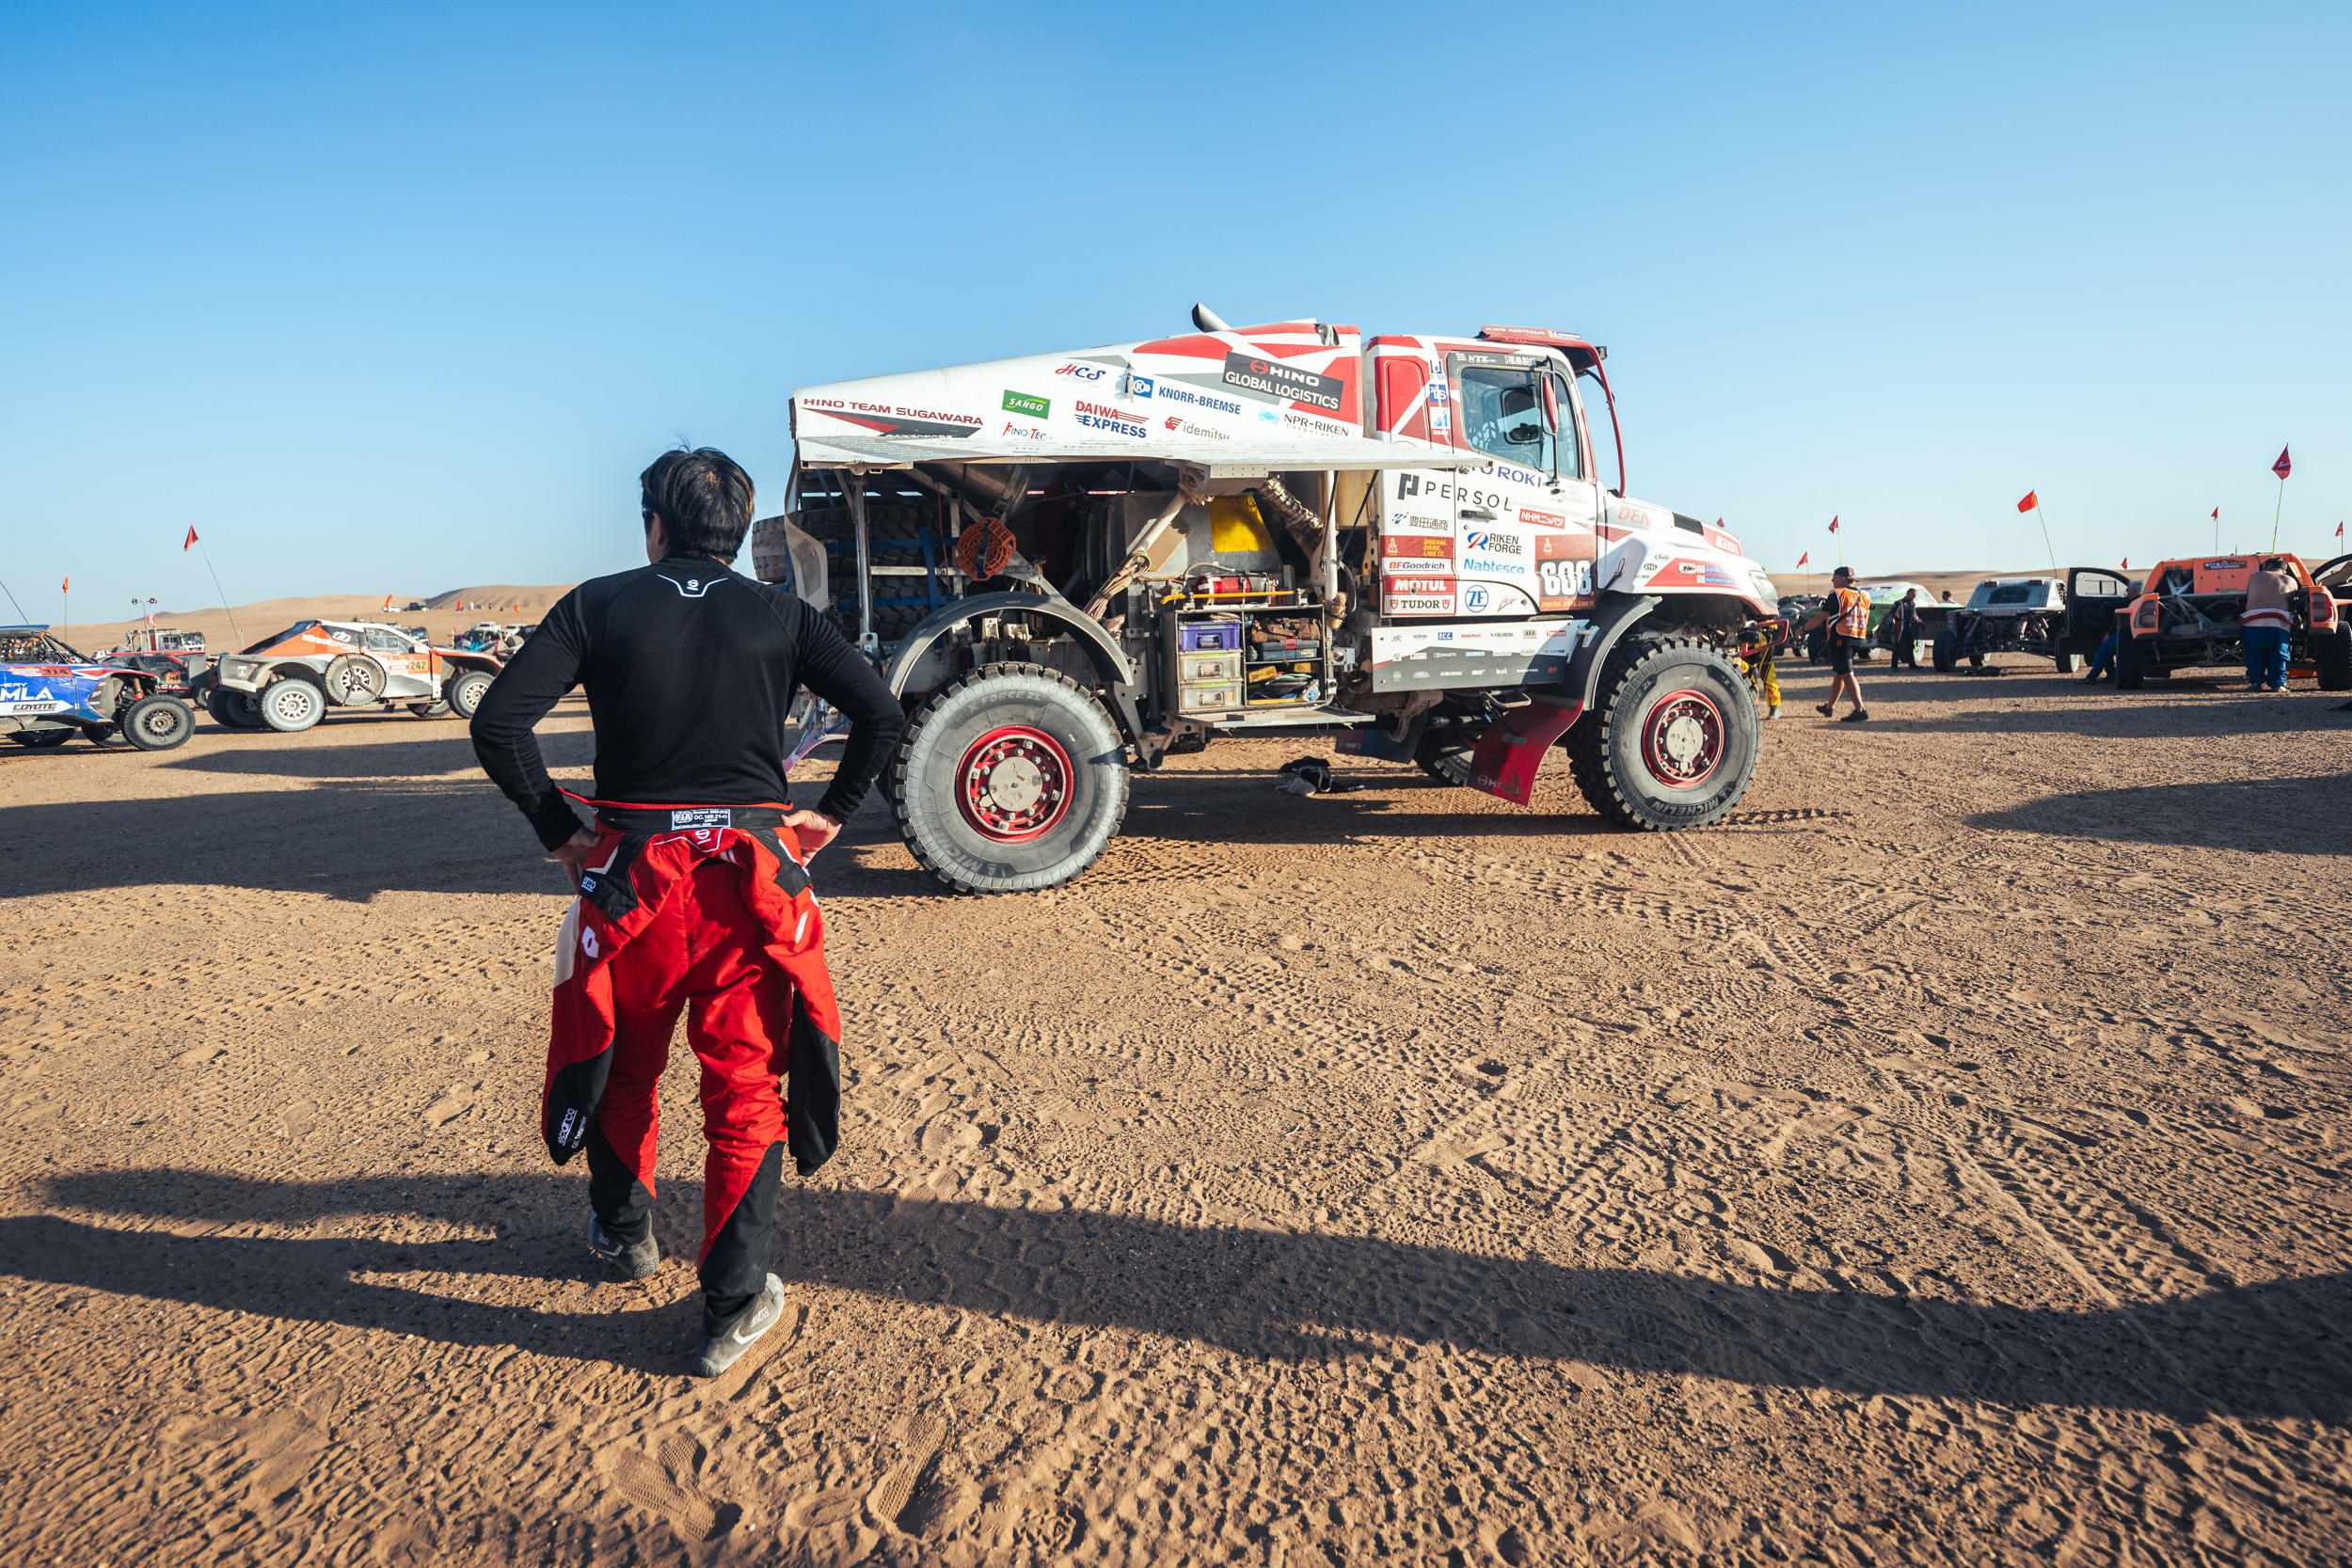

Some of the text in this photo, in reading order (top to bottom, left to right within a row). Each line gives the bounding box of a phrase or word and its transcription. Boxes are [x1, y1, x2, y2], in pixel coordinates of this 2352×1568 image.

[1056, 363, 1106, 380] HCS
[1270, 366, 1321, 387] HINO
[1225, 371, 1340, 410] GLOBAL LOGISTICS
[1009, 398, 1044, 412] SANGO
[1158, 387, 1242, 415] KNORR-BREMSE
[803, 399, 984, 425] HINO TEAM SUGAWARA
[1075, 400, 1120, 420] DAIWA
[1082, 415, 1147, 439] EXPRESS
[1283, 414, 1350, 437] NPR-RIKEN
[1497, 466, 1542, 487] ROKI
[1424, 481, 1513, 512] PERSOL
[1489, 532, 1518, 545] RIKEN
[1488, 543, 1522, 555] FORGE
[1389, 562, 1445, 570] BFGoodrich
[1464, 558, 1525, 575] Nabtesco
[1393, 579, 1447, 592] MOTUL
[1401, 600, 1440, 610] TUDOR
[1468, 591, 1486, 604] ZF
[410, 661, 426, 670] 242
[1652, 799, 1719, 816] MICHELIN
[557, 1108, 576, 1145] sparco
